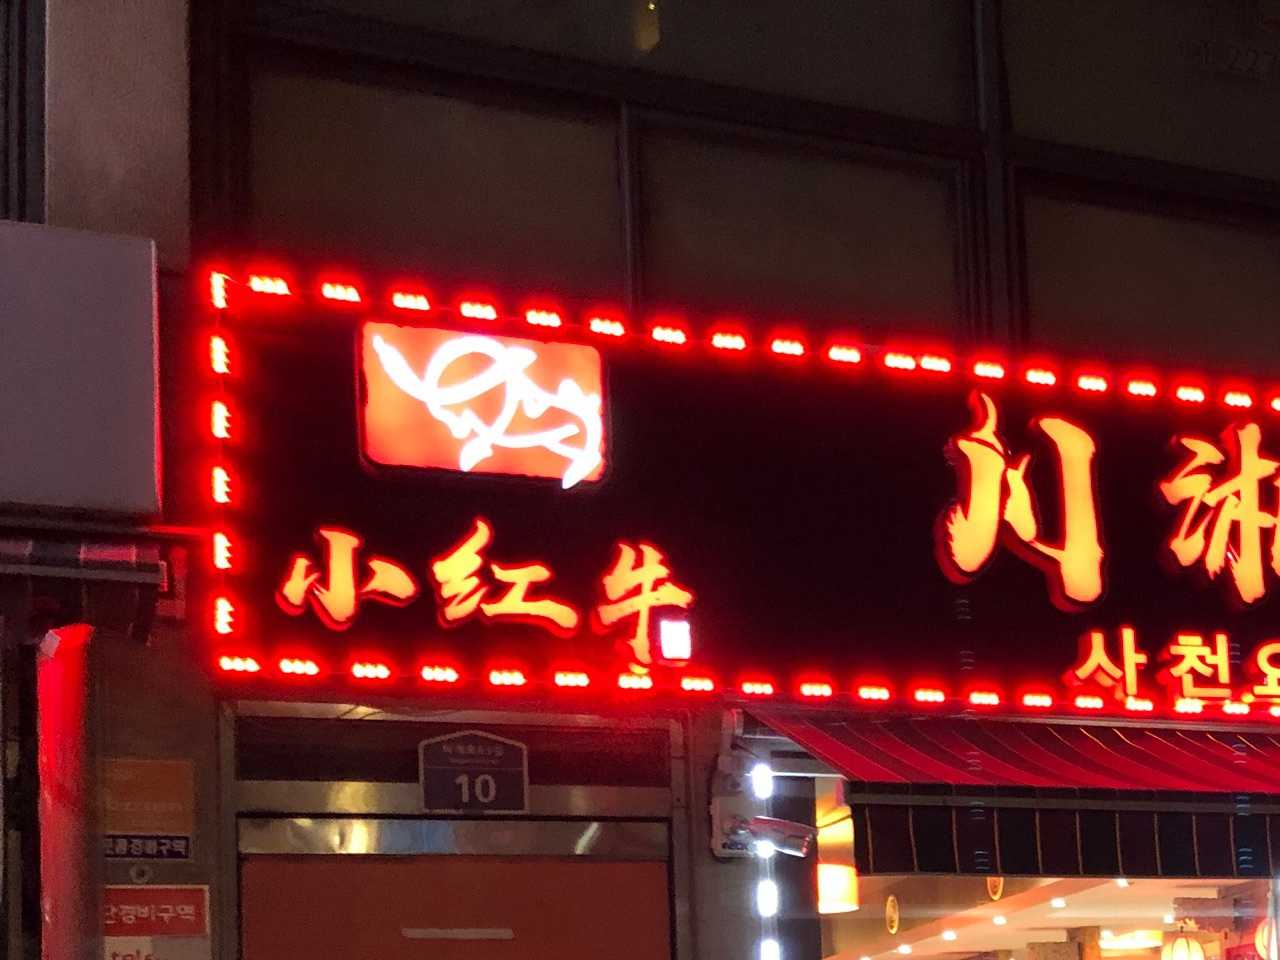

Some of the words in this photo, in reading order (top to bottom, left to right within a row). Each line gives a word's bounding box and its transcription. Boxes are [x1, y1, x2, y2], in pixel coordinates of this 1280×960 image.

[279, 519, 694, 668] 小红牛
[455, 773, 497, 804] 10
